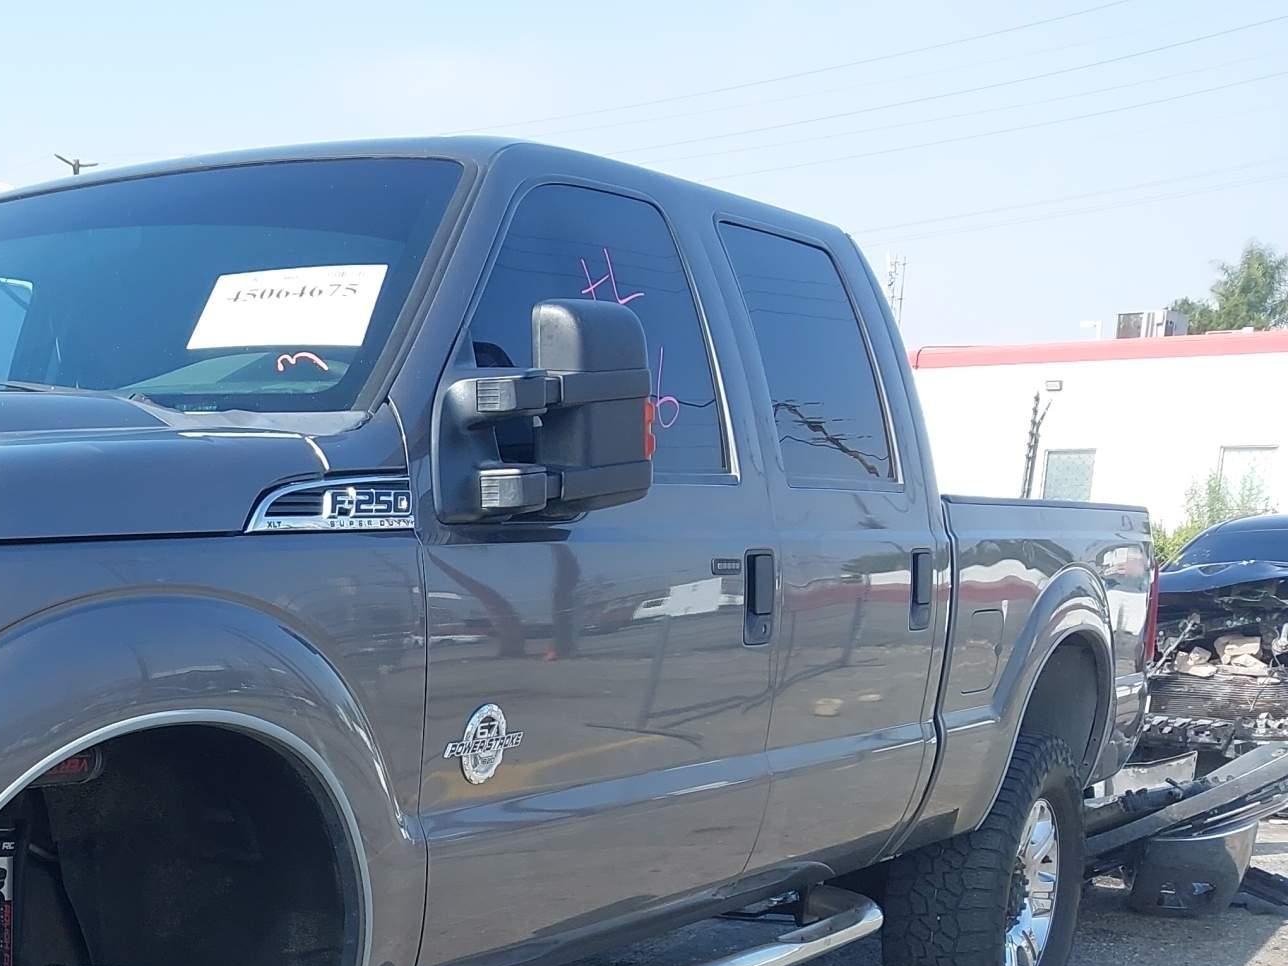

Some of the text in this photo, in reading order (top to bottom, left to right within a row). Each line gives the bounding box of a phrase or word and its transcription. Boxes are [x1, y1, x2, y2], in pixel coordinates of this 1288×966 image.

[267, 521, 282, 529] XLT
[330, 520, 373, 528] SUPER
[477, 721, 500, 738] 6.7
